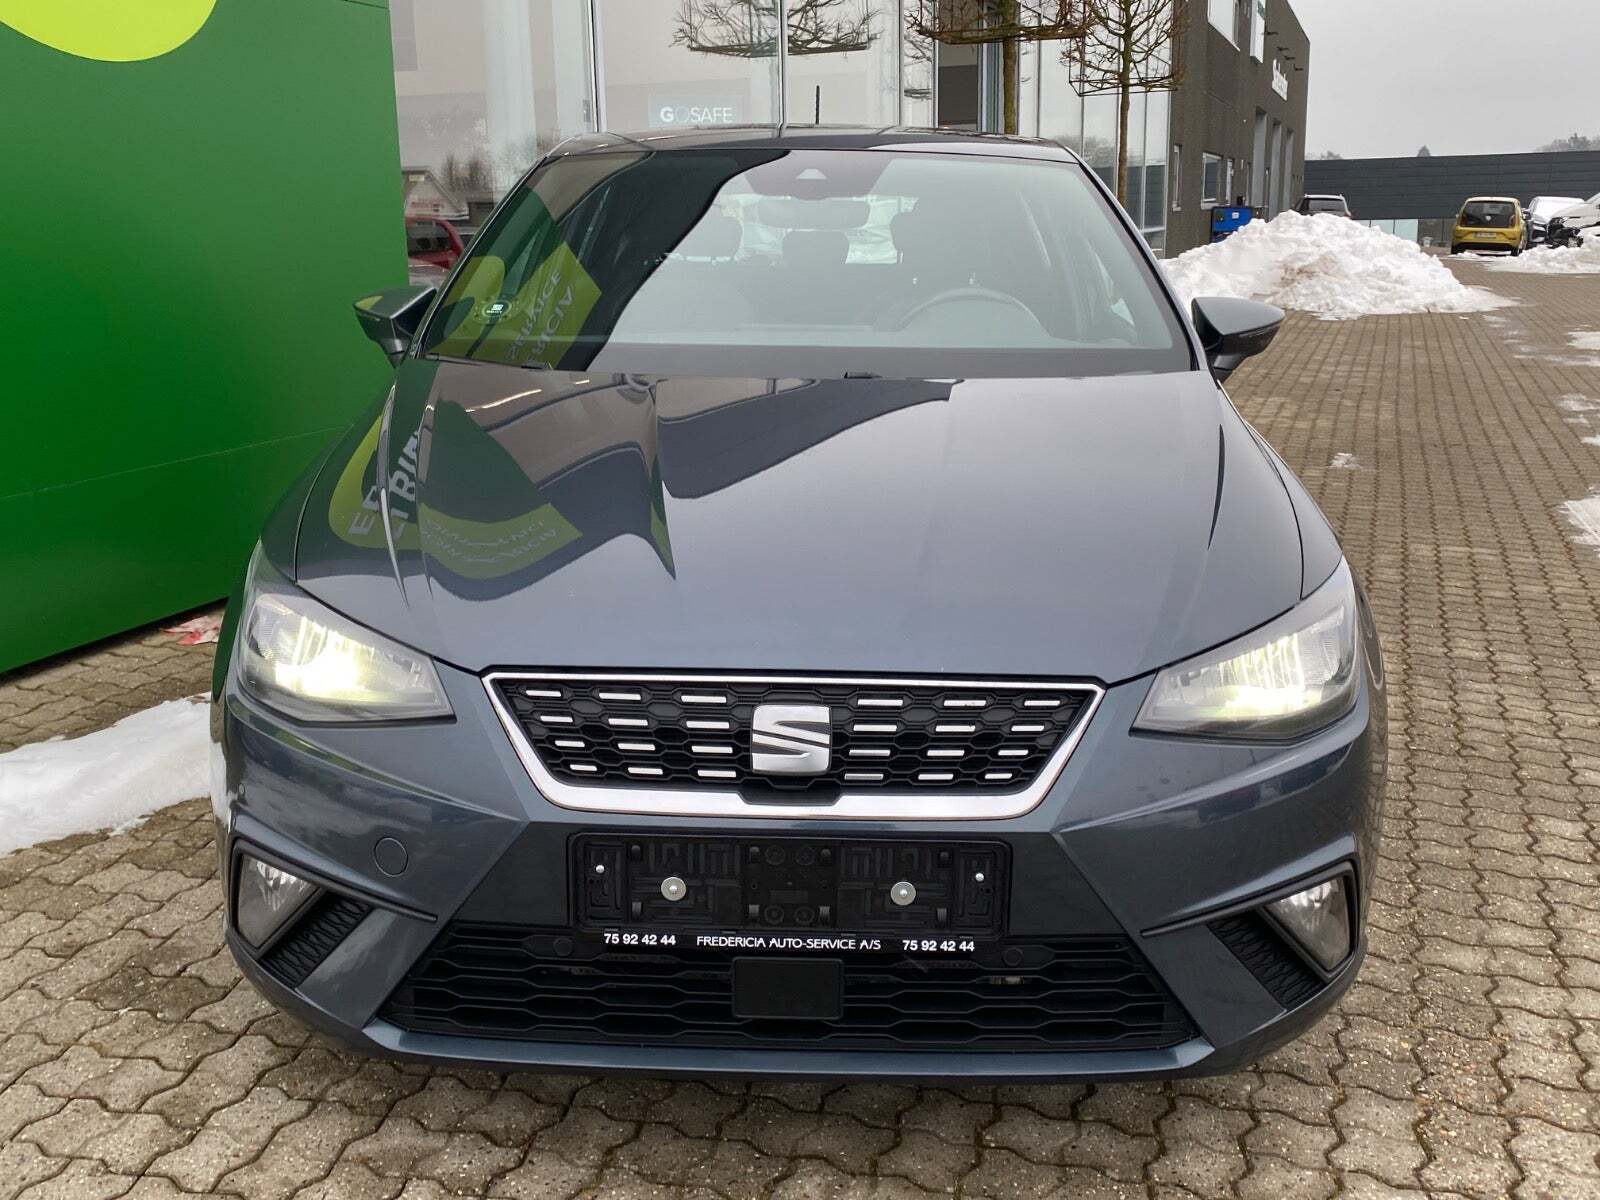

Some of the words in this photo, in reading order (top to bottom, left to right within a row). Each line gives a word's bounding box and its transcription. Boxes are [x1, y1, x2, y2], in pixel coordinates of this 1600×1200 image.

[603, 932, 620, 945] 75
[622, 933, 639, 945] 92
[641, 934, 658, 946] 42
[660, 934, 677, 946] 44
[696, 935, 767, 948] FREDERICIA
[768, 937, 856, 950] AUTO-SERVICE
[859, 939, 882, 950] A/S
[902, 939, 919, 951] 75
[920, 940, 938, 952] 92
[939, 940, 957, 952] 42
[958, 940, 975, 952] 44
